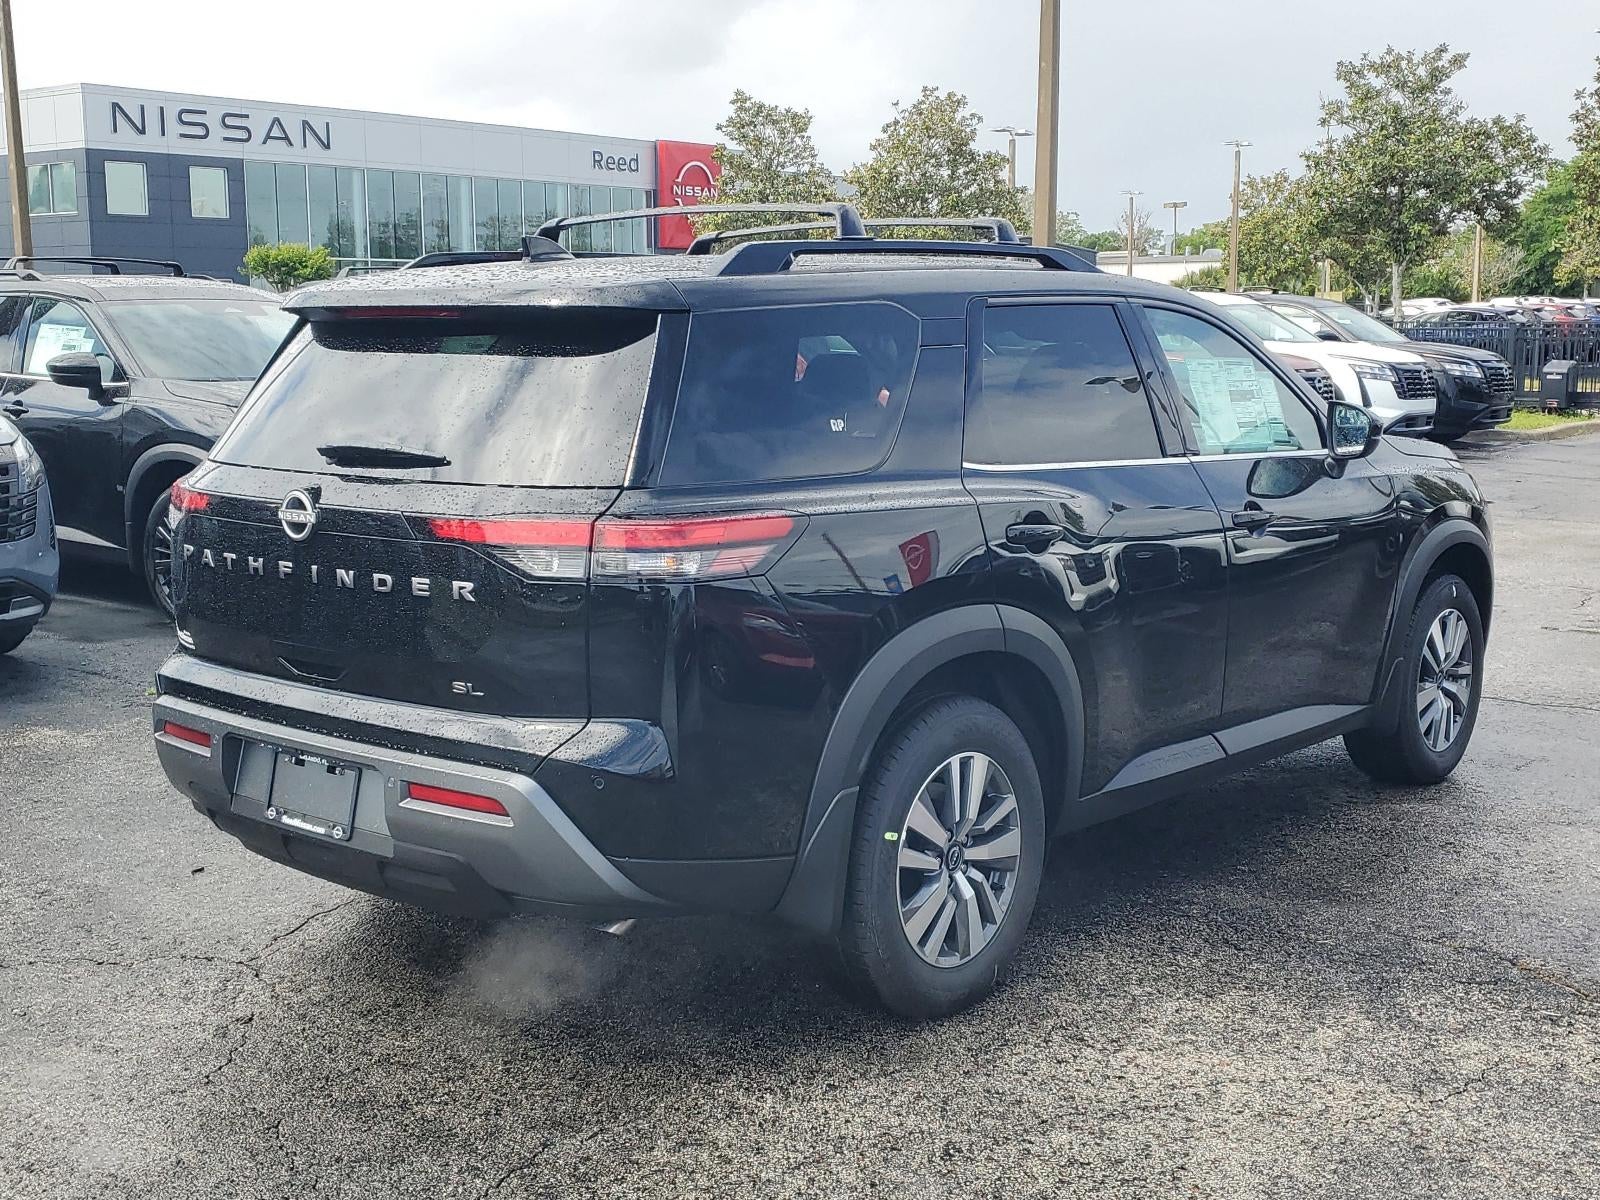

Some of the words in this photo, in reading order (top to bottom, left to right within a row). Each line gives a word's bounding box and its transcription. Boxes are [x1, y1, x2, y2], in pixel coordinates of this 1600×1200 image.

[111, 101, 332, 150] NISSAN
[592, 150, 639, 172] Reed
[673, 185, 718, 197] NISSAN
[278, 510, 314, 523] NISSAN
[183, 544, 476, 602] PATHFINDER
[452, 681, 485, 696] SL
